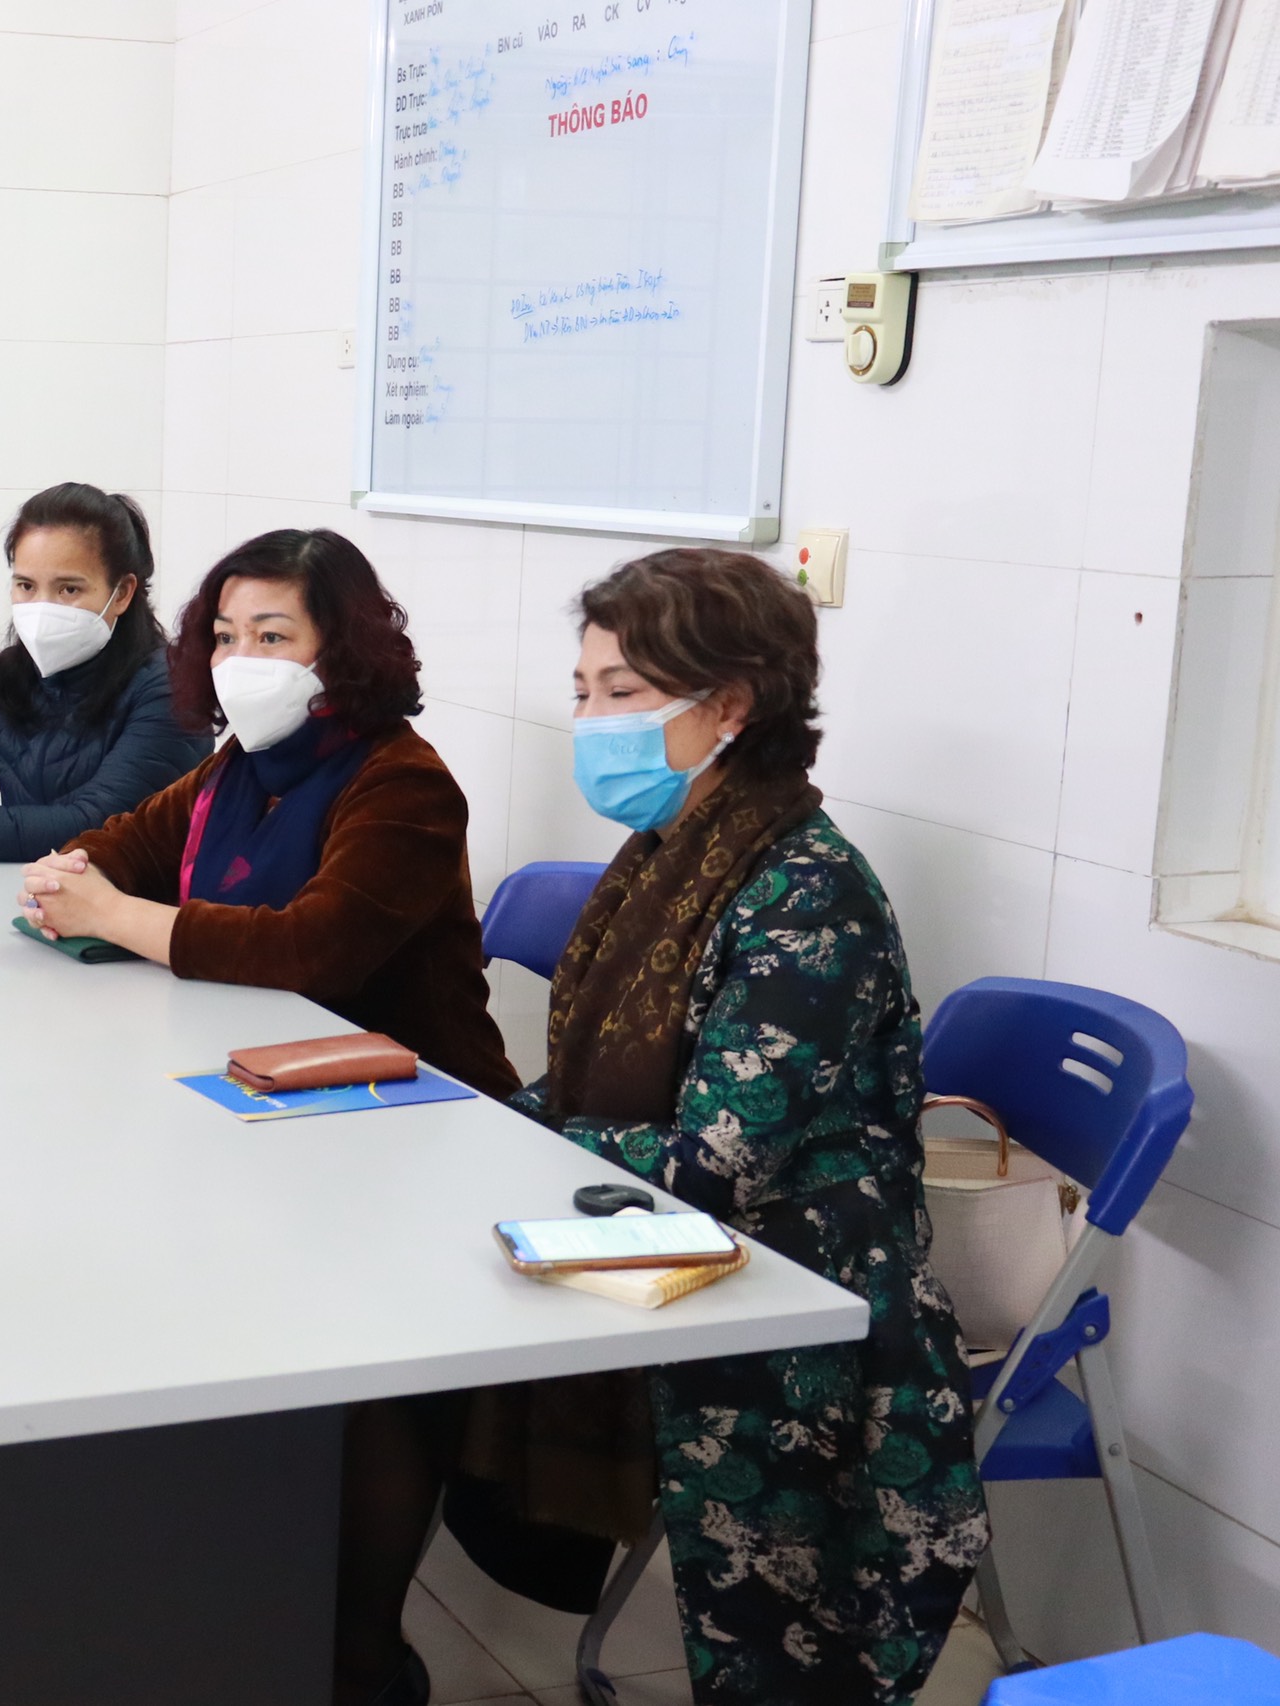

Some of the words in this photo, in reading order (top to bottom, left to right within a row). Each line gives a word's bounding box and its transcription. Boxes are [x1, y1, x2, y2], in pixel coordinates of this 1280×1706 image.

[403, 7, 426, 26] XANH
[497, 37, 511, 54] BN
[537, 19, 559, 43] VÀO
[572, 13, 587, 33] RA
[604, 2, 620, 22] CK
[396, 67, 407, 84] Bs
[395, 96, 408, 113] ĐD
[548, 102, 606, 138] THÔNG
[610, 89, 649, 125] BÁO
[394, 125, 412, 144] Trực
[392, 182, 404, 199] BB
[391, 211, 403, 228] BB
[391, 239, 403, 256] BB
[390, 268, 402, 285] BB
[388, 296, 401, 313] BB
[387, 325, 400, 341] BB
[386, 354, 407, 373] Dụng
